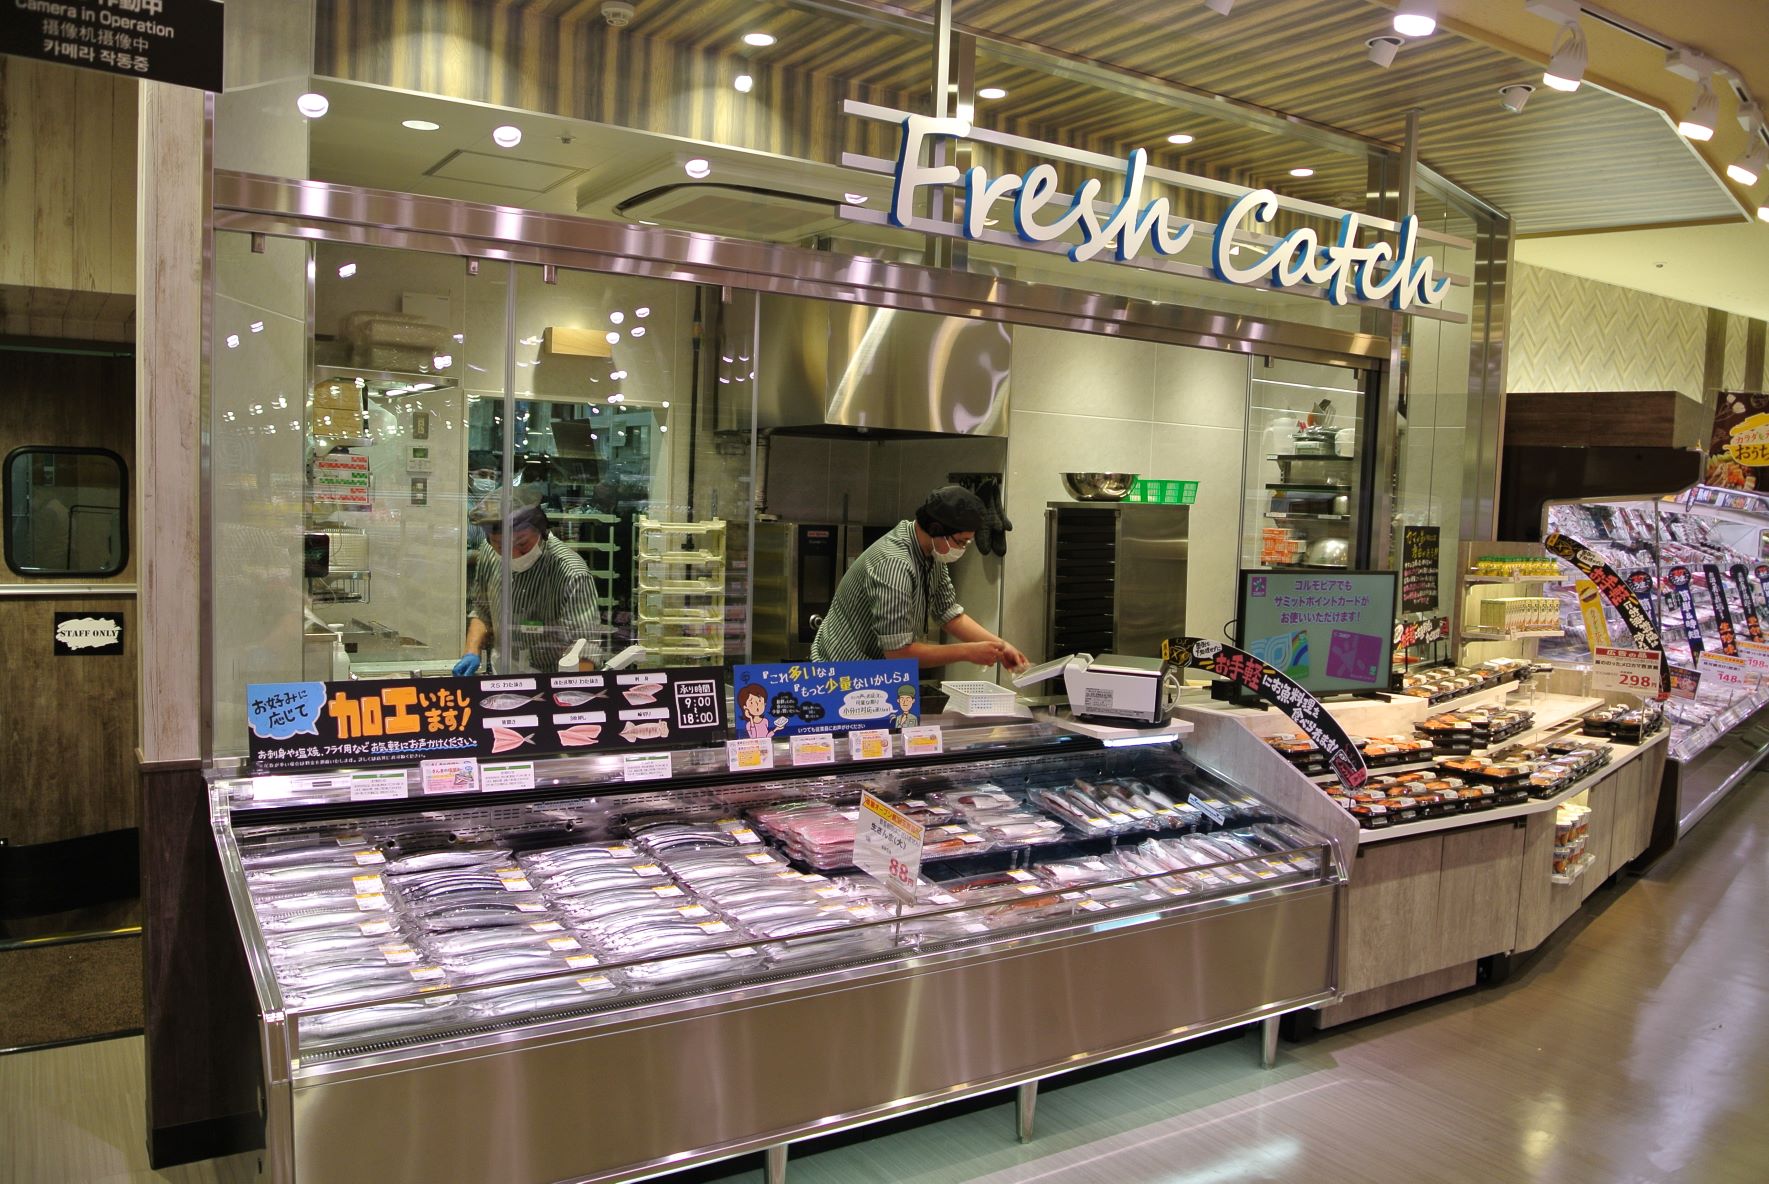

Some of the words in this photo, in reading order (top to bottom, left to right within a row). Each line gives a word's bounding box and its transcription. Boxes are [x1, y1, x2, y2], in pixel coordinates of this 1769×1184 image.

[15, 0, 77, 19] Camera
[82, 6, 95, 22] in
[100, 11, 174, 38] Operation
[43, 38, 95, 62] 카메라
[100, 49, 149, 73] 작동중
[889, 114, 1194, 263] Fresh
[1213, 188, 1451, 310] Catch
[1590, 568, 1630, 606] お手軽
[1274, 596, 1370, 608] サミットポイントカードが
[1281, 612, 1361, 624] お使いいただけます!
[1215, 652, 1264, 691] お手軽
[252, 688, 308, 715] お好みに
[419, 688, 470, 708] いたし
[680, 685, 711, 694] 承り時間
[685, 696, 711, 708] 9:00
[1262, 674, 1321, 719] にお魚料理を
[269, 704, 309, 729] 応じて
[329, 686, 421, 740] 加工
[425, 707, 472, 732] ます!
[682, 712, 714, 724] 18:00
[1291, 707, 1339, 753] 食べられます!
